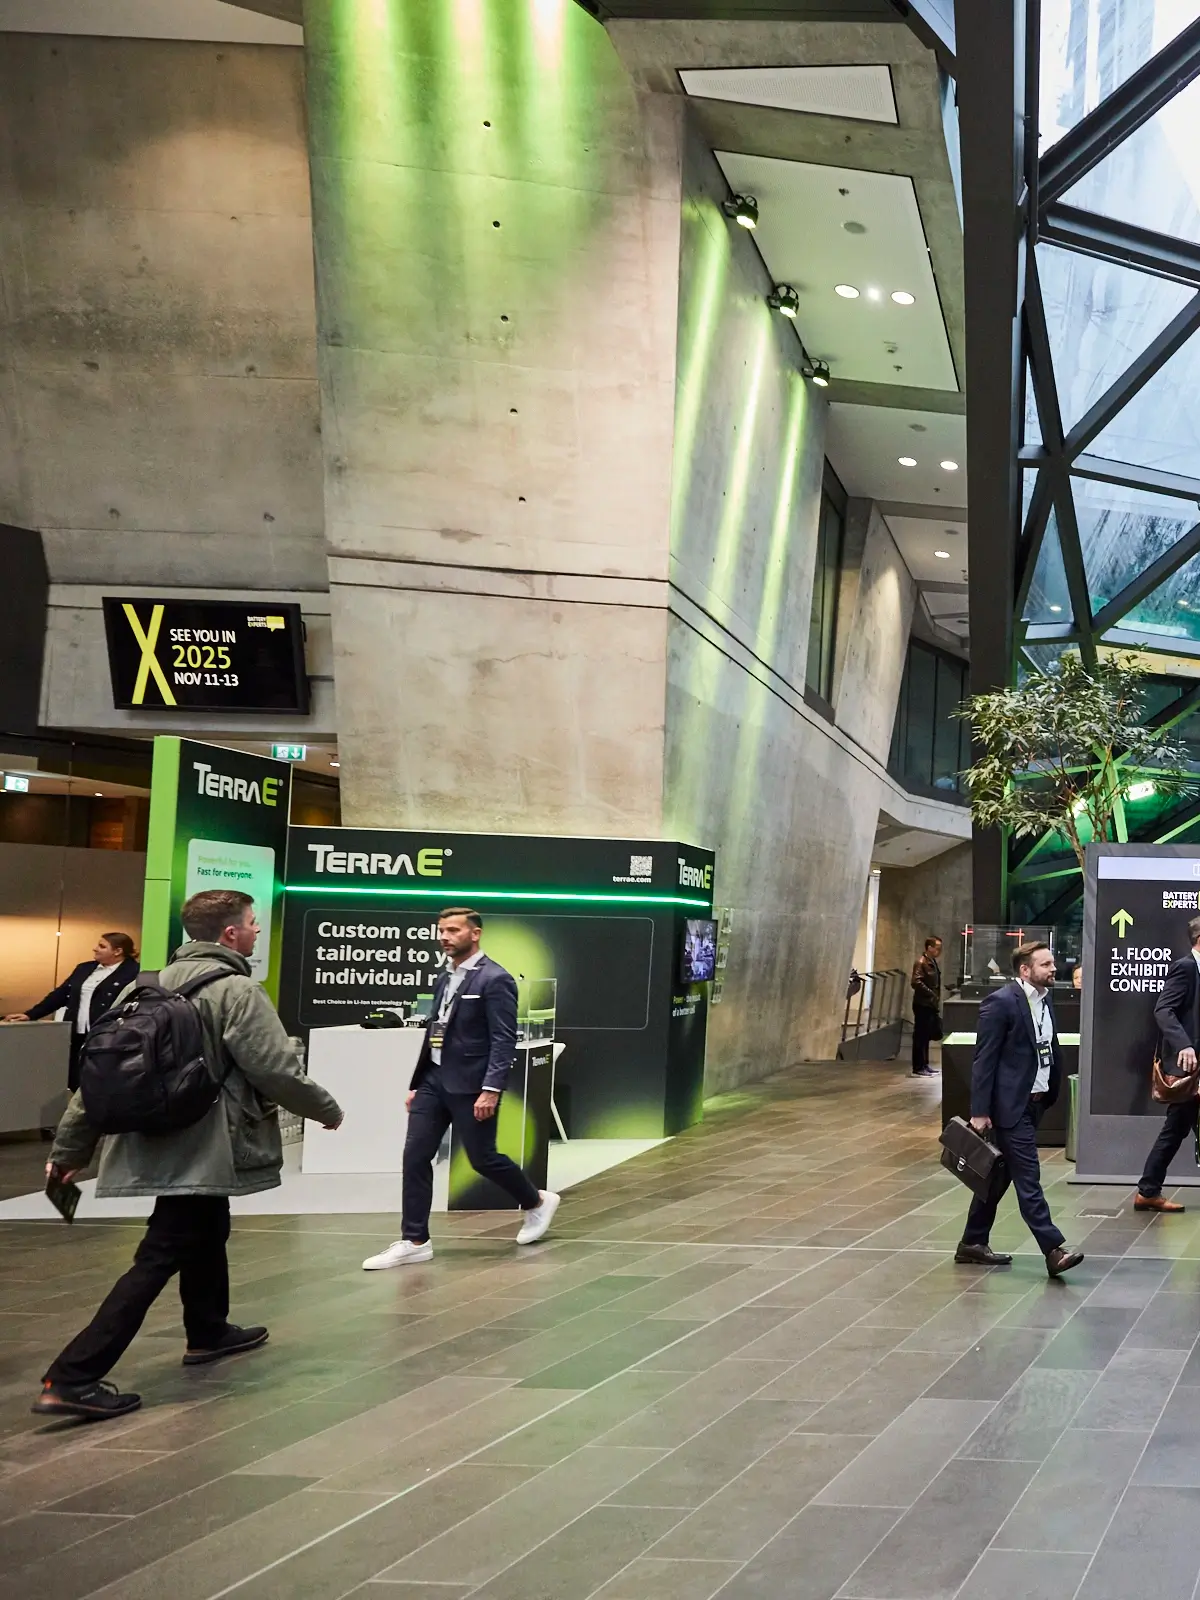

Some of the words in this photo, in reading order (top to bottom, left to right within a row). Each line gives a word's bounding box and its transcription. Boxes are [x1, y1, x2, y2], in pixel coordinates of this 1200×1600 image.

[170, 628, 192, 642] SEE
[194, 629, 220, 642] YOU
[222, 630, 236, 644] IN
[172, 645, 232, 670] 2025
[174, 672, 202, 686] NOV
[204, 674, 239, 687] 11-13
[197, 867, 211, 876] Fast
[212, 868, 223, 876] for
[224, 870, 254, 880] everyone.
[612, 876, 652, 884] terrae.com
[1163, 890, 1198, 900] BATTERY
[1163, 900, 1198, 910] EXPERTS
[318, 922, 400, 940] Custom
[316, 945, 400, 963] tailored
[406, 947, 430, 964] to
[1111, 948, 1124, 961] 1.
[1126, 948, 1172, 962] FLOOR
[315, 967, 422, 986] individual
